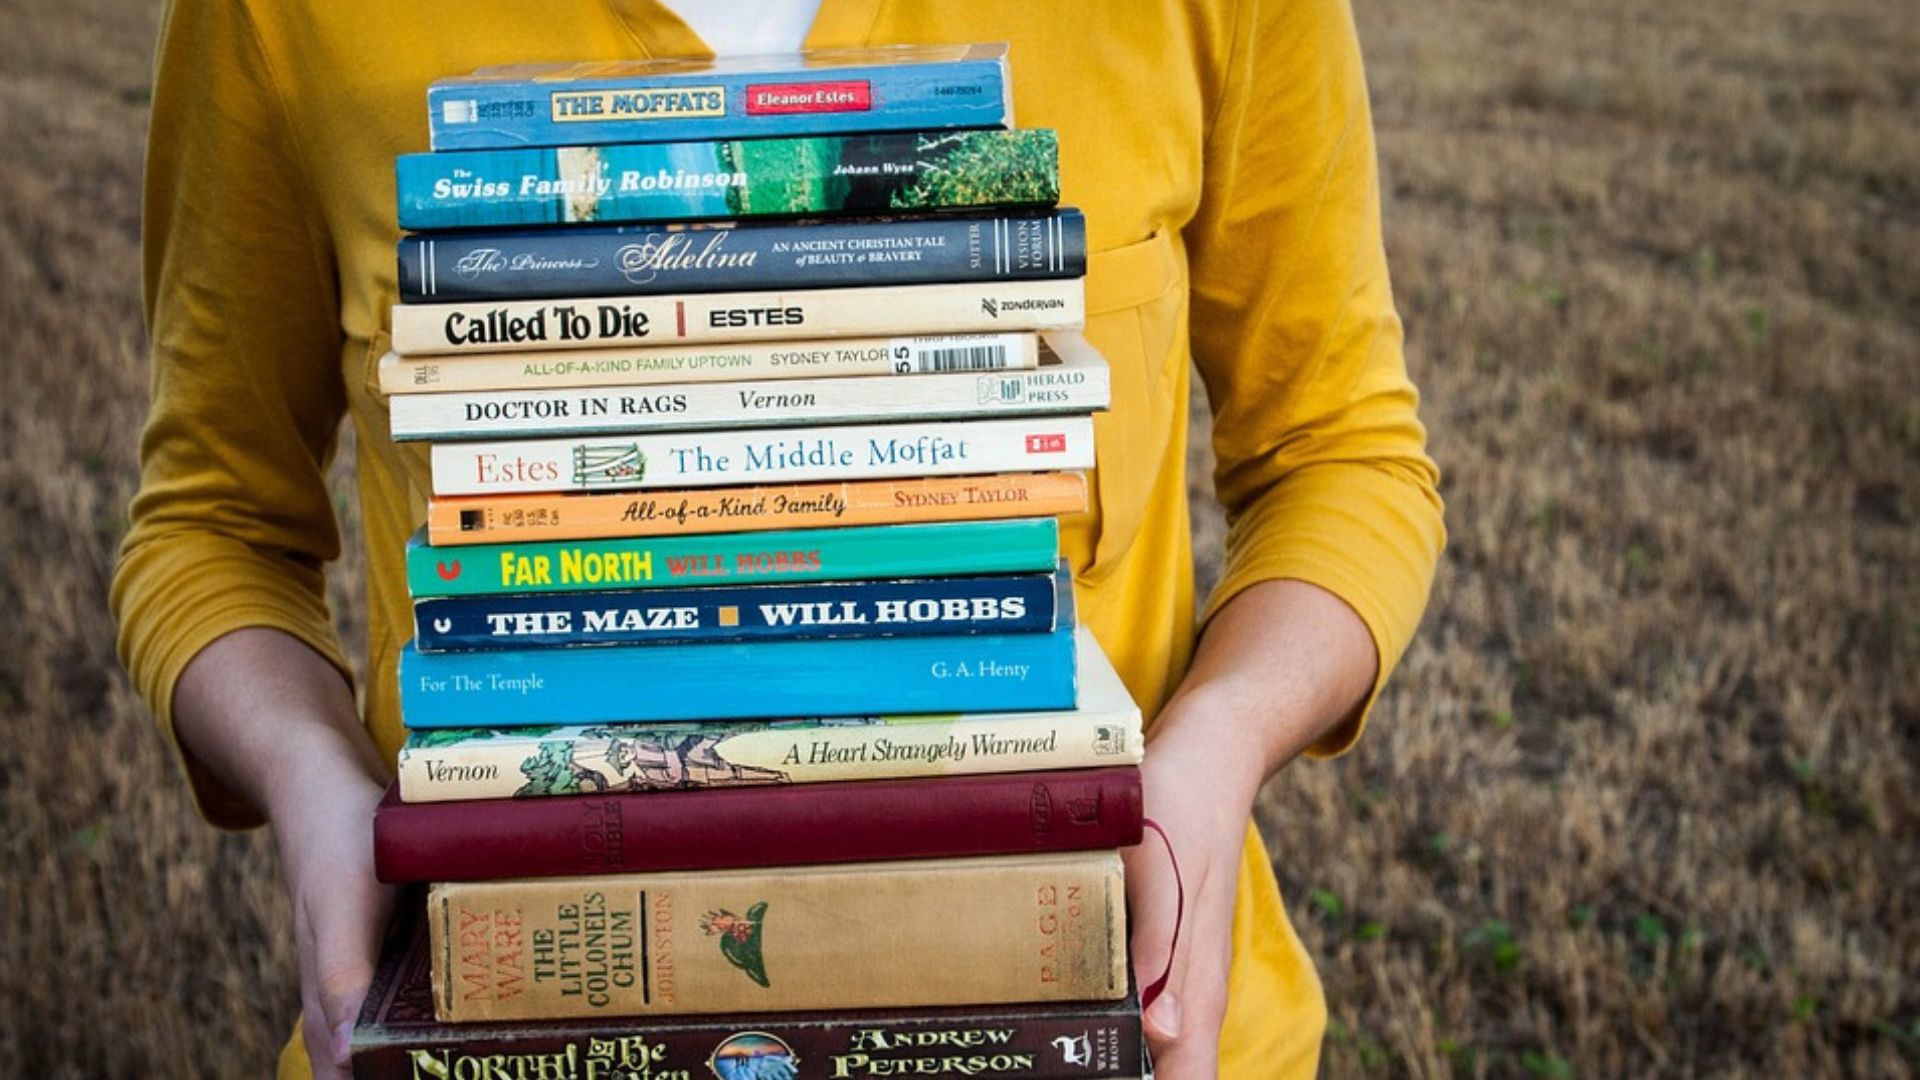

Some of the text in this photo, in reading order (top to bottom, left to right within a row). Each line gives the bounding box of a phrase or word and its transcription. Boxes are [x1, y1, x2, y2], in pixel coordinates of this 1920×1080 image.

[556, 94, 604, 116] THE
[611, 91, 722, 114] MOFFATS
[757, 90, 855, 105] Eleanor Estes
[432, 168, 748, 198] Swiss Family Robinson
[453, 169, 472, 179] The
[833, 163, 879, 175] Johann
[614, 231, 758, 284] Adelina
[771, 235, 946, 252] AN ANCIENT CHRISTIAN TALE
[796, 255, 808, 268] of
[808, 252, 854, 265] BEAUTY
[868, 251, 923, 263] BRAVERY
[970, 223, 982, 270] SUTTER
[1018, 220, 1029, 269] VISION
[1030, 219, 1043, 268] FORUM
[453, 248, 601, 281] The Princess
[445, 304, 650, 345] Called To Die
[709, 307, 804, 328] ESTES
[523, 354, 753, 376] ALL-OF-A-KIND FAMILY UPTOWN
[770, 348, 890, 366] SYDNEY TAYLOR
[1026, 372, 1084, 386] HERALD
[465, 394, 688, 421] DOCTOR IN RAGS
[739, 390, 816, 409] Vernon
[1029, 390, 1069, 402] PRESS
[475, 453, 559, 484] Estes
[669, 436, 969, 474] The Middle Moffat
[620, 492, 847, 525] All-of-a-Kind Family
[894, 486, 1029, 508] SYDNEY TAYLOR
[500, 549, 822, 587] FAR NORTH WILL HOBBS
[487, 596, 1027, 636] THE MAZE WILL HOBBS
[421, 673, 545, 695] For The Temple
[931, 659, 1030, 680] G. A. Henty
[782, 730, 1058, 766] A Heart Strangely Warmed
[424, 759, 500, 783] Vernon
[583, 801, 603, 865] HOLY
[605, 800, 624, 867] BIBLE
[558, 903, 584, 998] LITTLE
[610, 910, 635, 988] CHUM
[655, 892, 675, 1003] JOHNSTON
[1036, 884, 1059, 984] PAGE
[459, 907, 492, 1002] MARY
[495, 907, 524, 1001] WARE
[532, 928, 556, 983] THE
[851, 1029, 1015, 1051] ANDREW
[1097, 1027, 1107, 1071] WATER
[1110, 1026, 1120, 1071] BROOK
[409, 1042, 578, 1080] NORTH!
[615, 1035, 668, 1070] Be
[830, 1052, 1036, 1079] PETERSON
